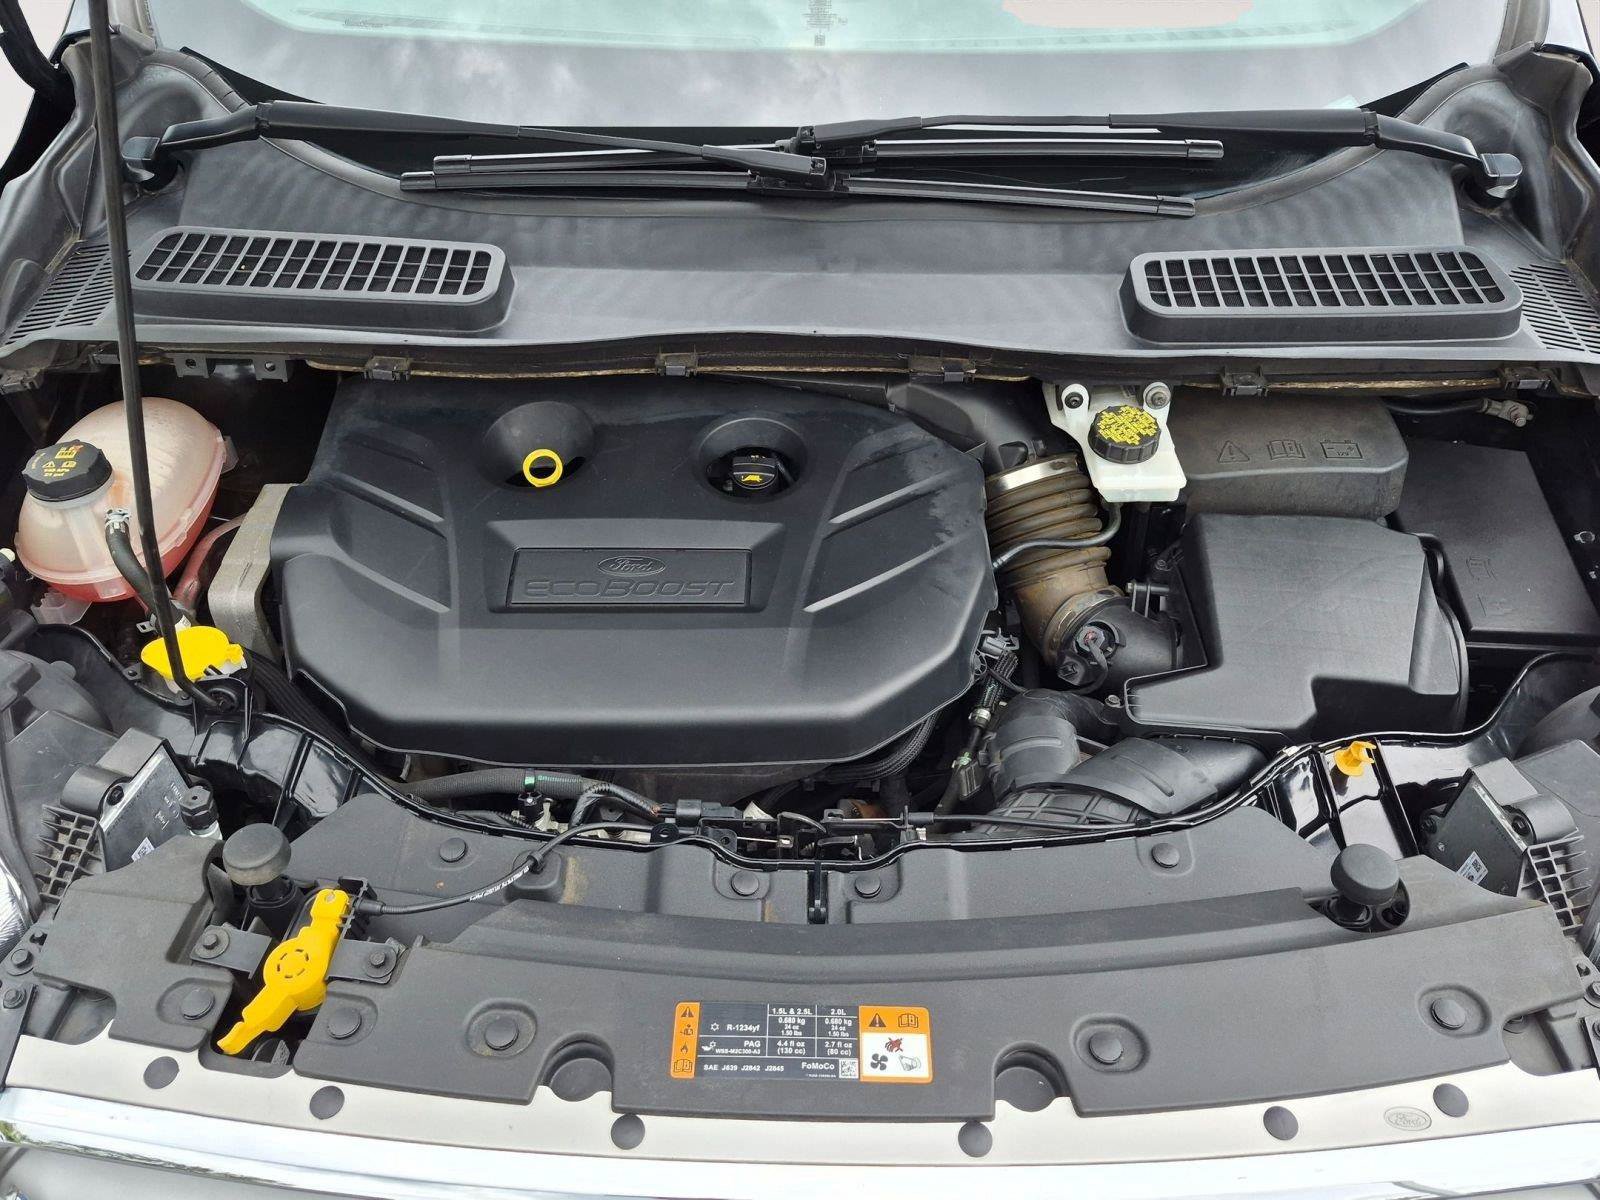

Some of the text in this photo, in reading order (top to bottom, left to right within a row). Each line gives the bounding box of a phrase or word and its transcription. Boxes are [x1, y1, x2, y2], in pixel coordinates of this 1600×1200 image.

[610, 558, 654, 572] Ford
[726, 1024, 760, 1032] R-1234yf
[801, 1062, 835, 1070] FoMoCo
